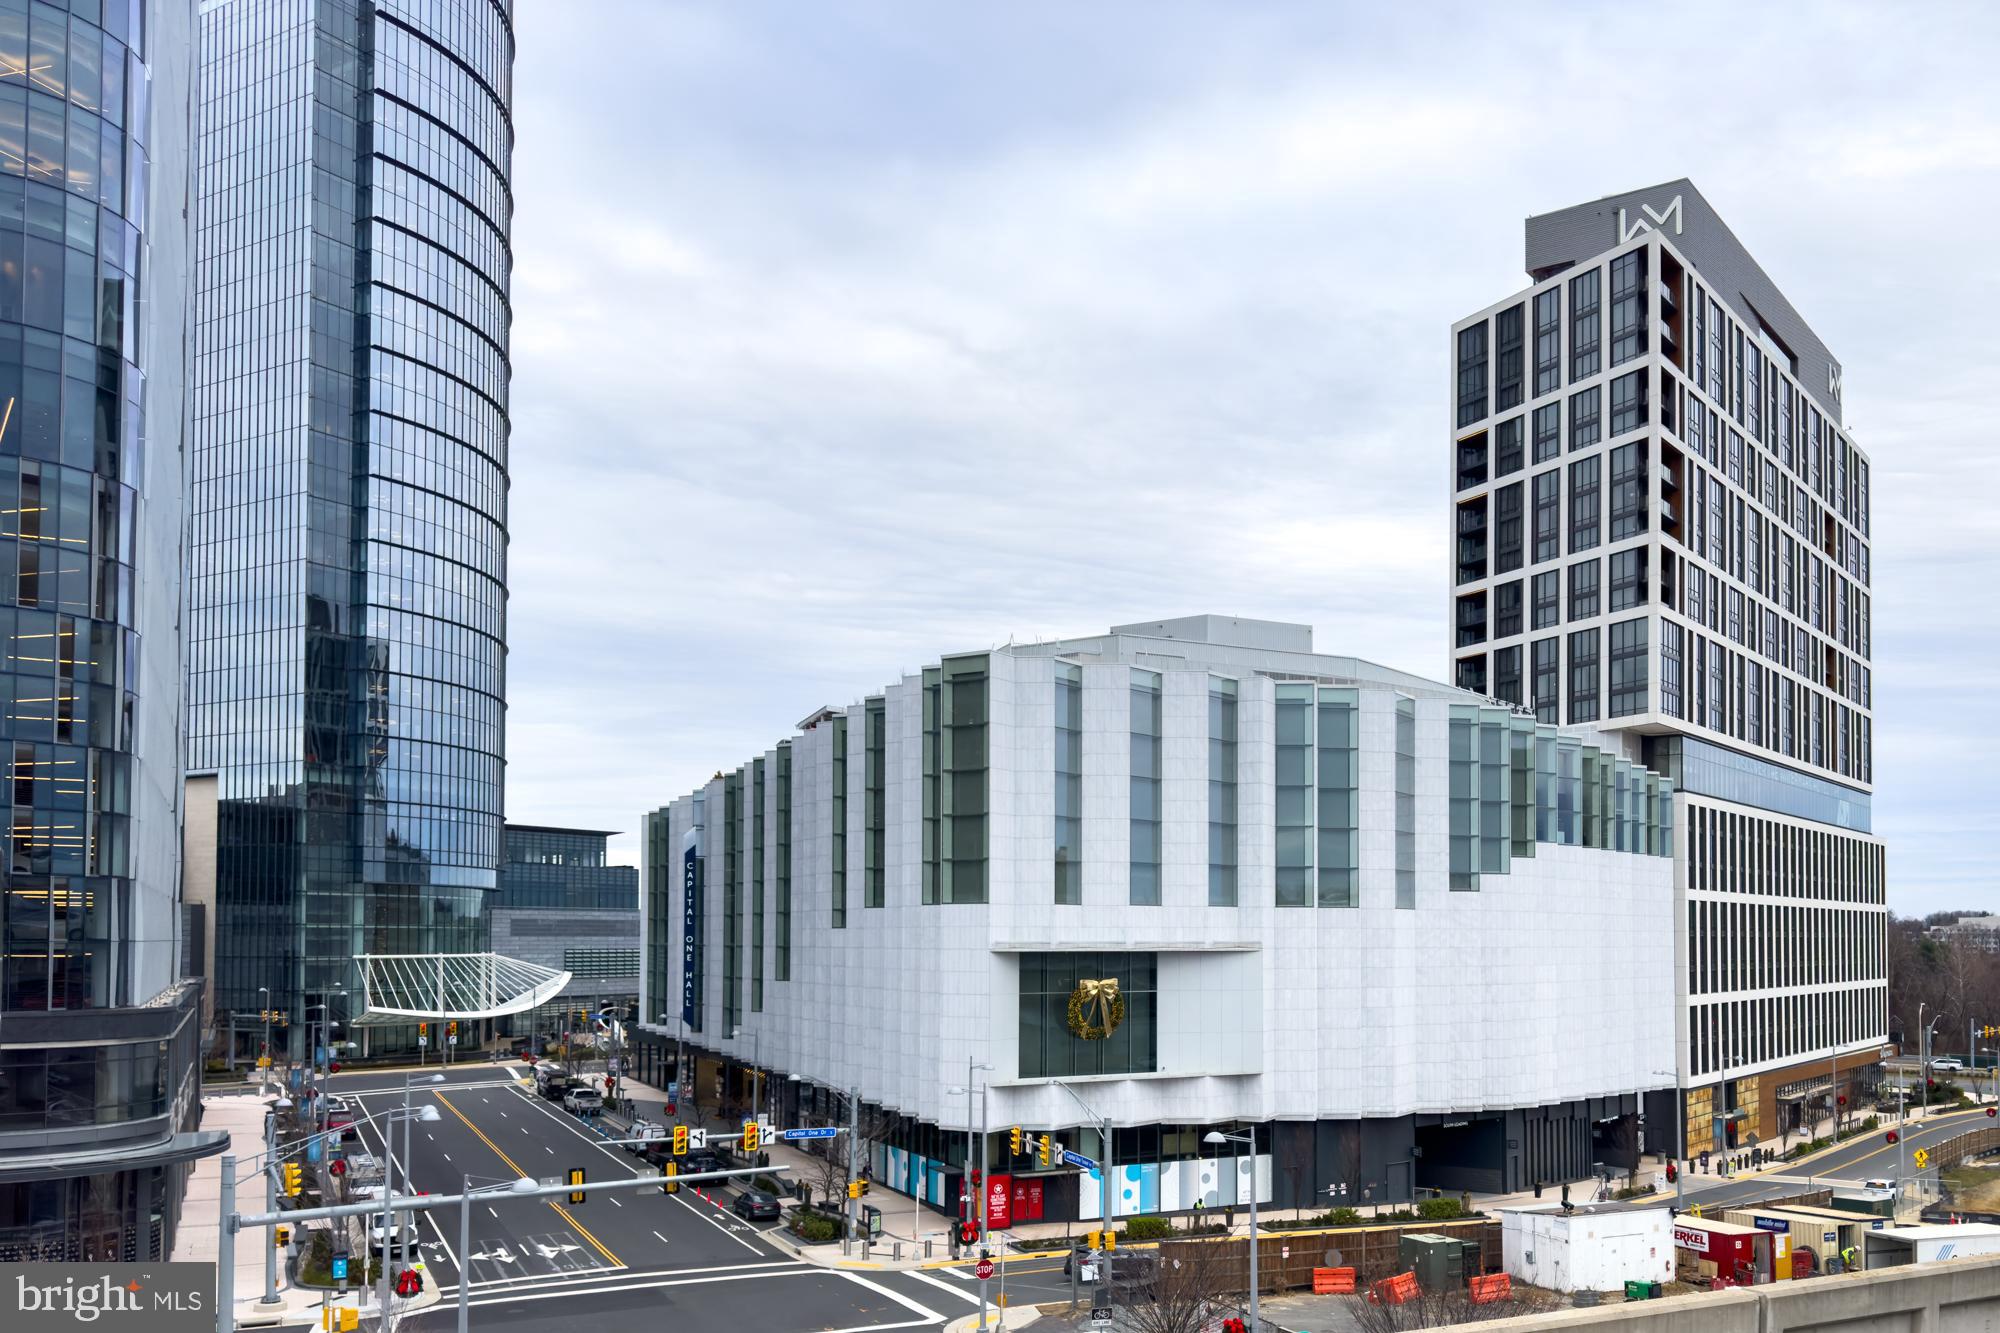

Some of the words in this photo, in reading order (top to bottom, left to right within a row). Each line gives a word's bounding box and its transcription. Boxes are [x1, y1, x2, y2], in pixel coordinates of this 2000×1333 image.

[686, 862, 694, 925] CAPITAL
[686, 936, 694, 961] ONE
[685, 972, 693, 1007] HALL
[1674, 1231, 1706, 1246] ERKEL
[976, 1264, 993, 1274] STOP
